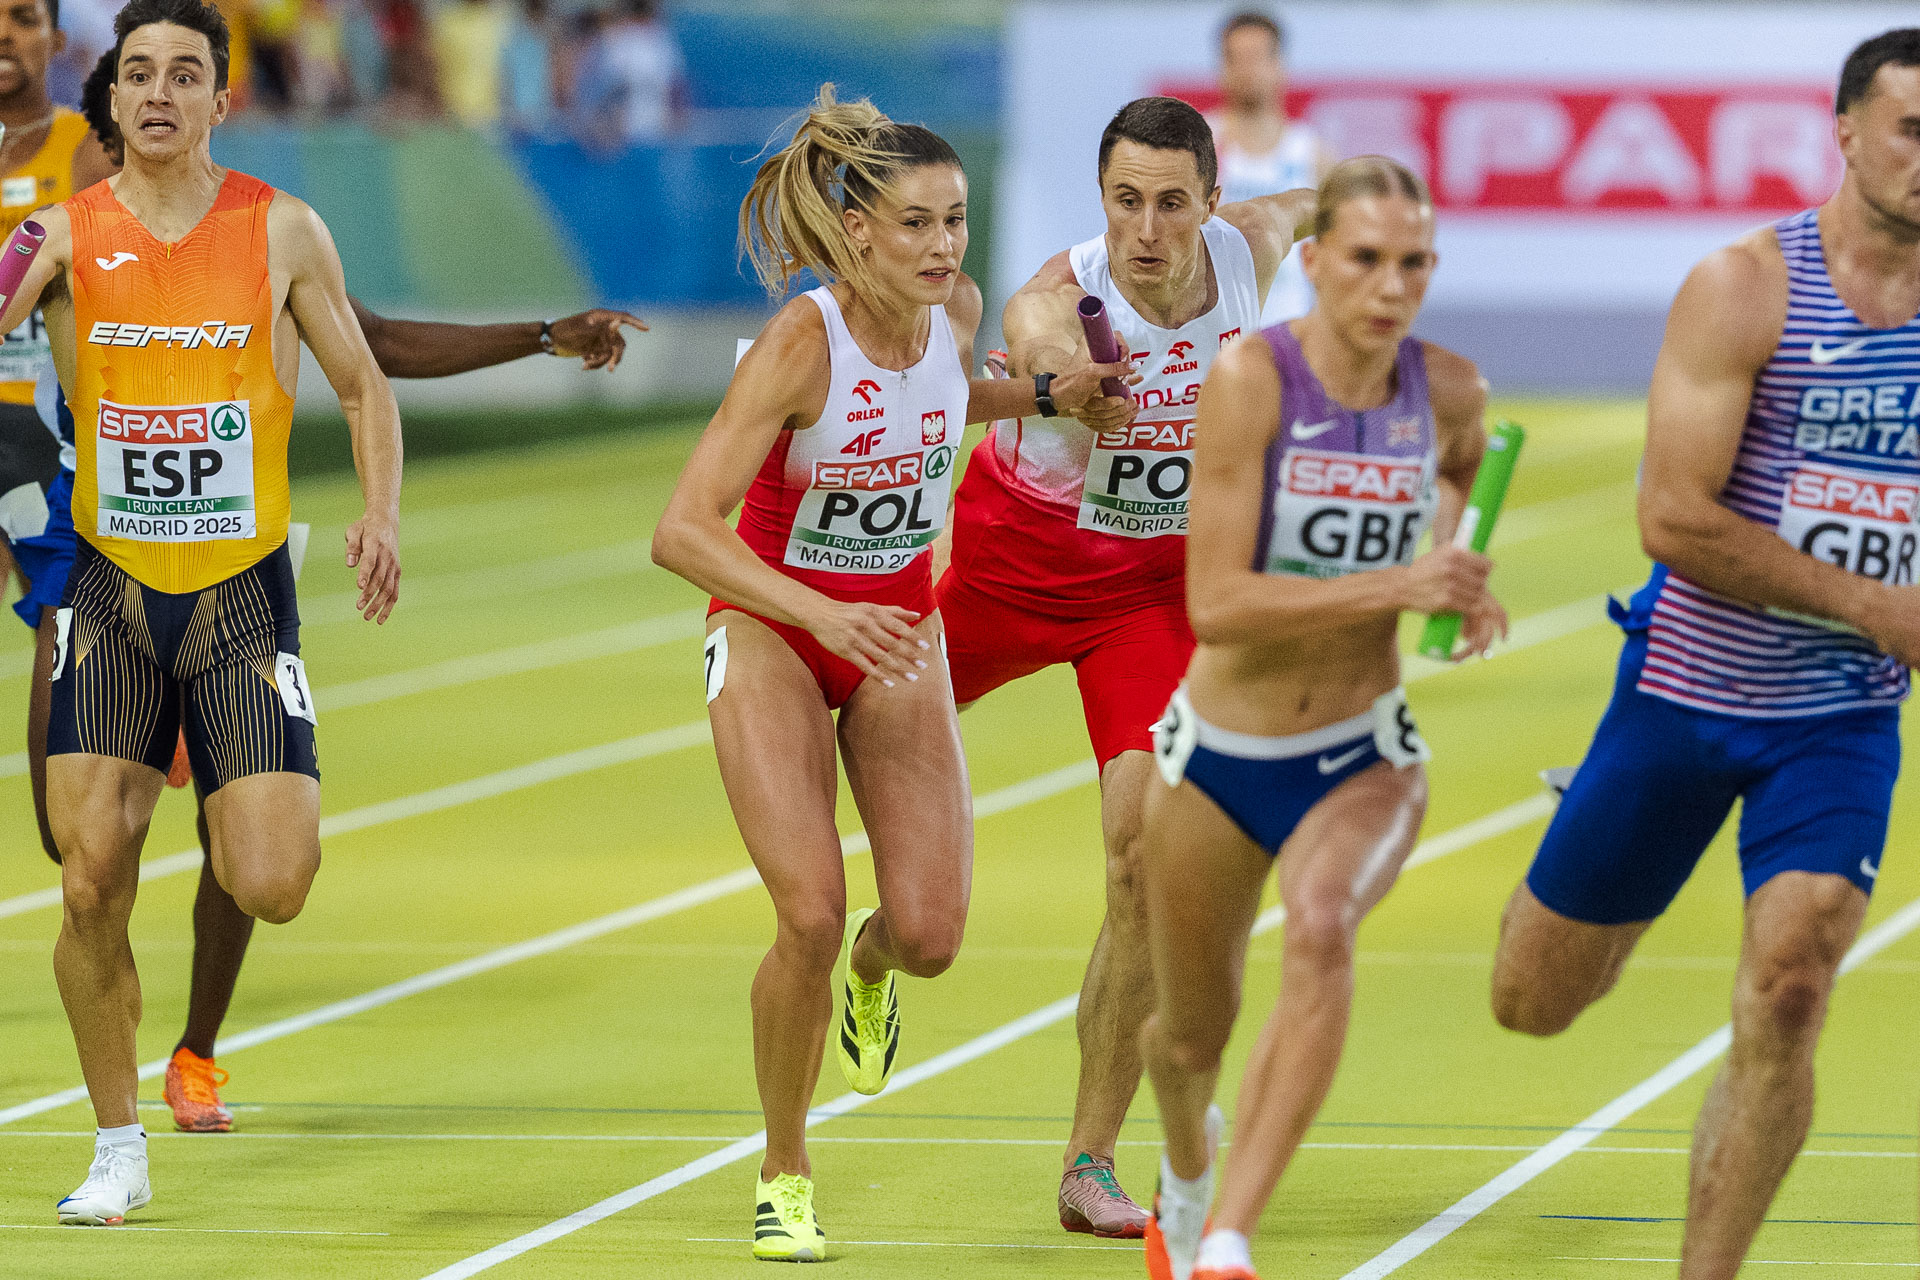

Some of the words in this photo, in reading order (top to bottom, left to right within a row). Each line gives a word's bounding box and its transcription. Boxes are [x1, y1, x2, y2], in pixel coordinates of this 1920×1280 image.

[88, 321, 253, 349] ESPAÑA
[1162, 361, 1198, 375] ORLEN
[847, 407, 884, 423] ORLEN
[1801, 386, 1920, 420] GREA
[102, 409, 206, 439] SPAR
[840, 427, 887, 456] 4F
[122, 448, 223, 498] ESP
[818, 457, 919, 488] SPAR
[1107, 455, 1194, 500] PO
[1292, 458, 1420, 500] SPAR
[133, 501, 163, 513] RUN
[1123, 501, 1156, 514] RUN
[1793, 472, 1917, 518] SPAR
[110, 516, 188, 536] MADRID
[193, 516, 242, 535] 2025
[817, 487, 932, 536] POL
[1092, 508, 1174, 534] MADRID
[799, 546, 885, 569] MADRID
[832, 537, 866, 550] RUN
[1801, 522, 1917, 586] GBR
